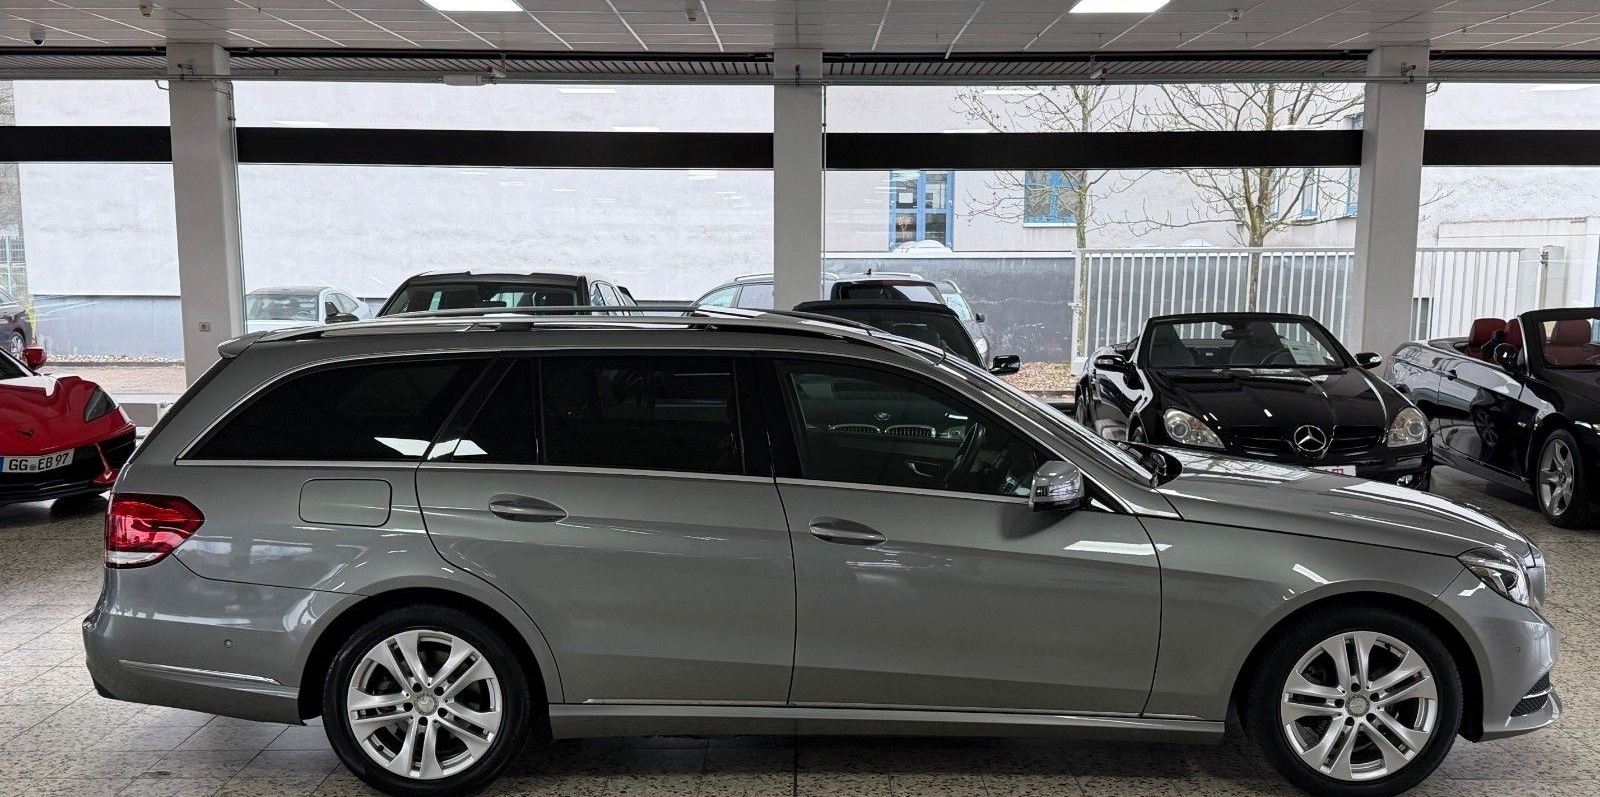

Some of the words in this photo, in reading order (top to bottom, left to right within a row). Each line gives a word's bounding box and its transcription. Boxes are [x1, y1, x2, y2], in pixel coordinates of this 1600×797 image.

[9, 459, 28, 470] GG
[38, 457, 53, 470] EB
[55, 453, 69, 466] 97
